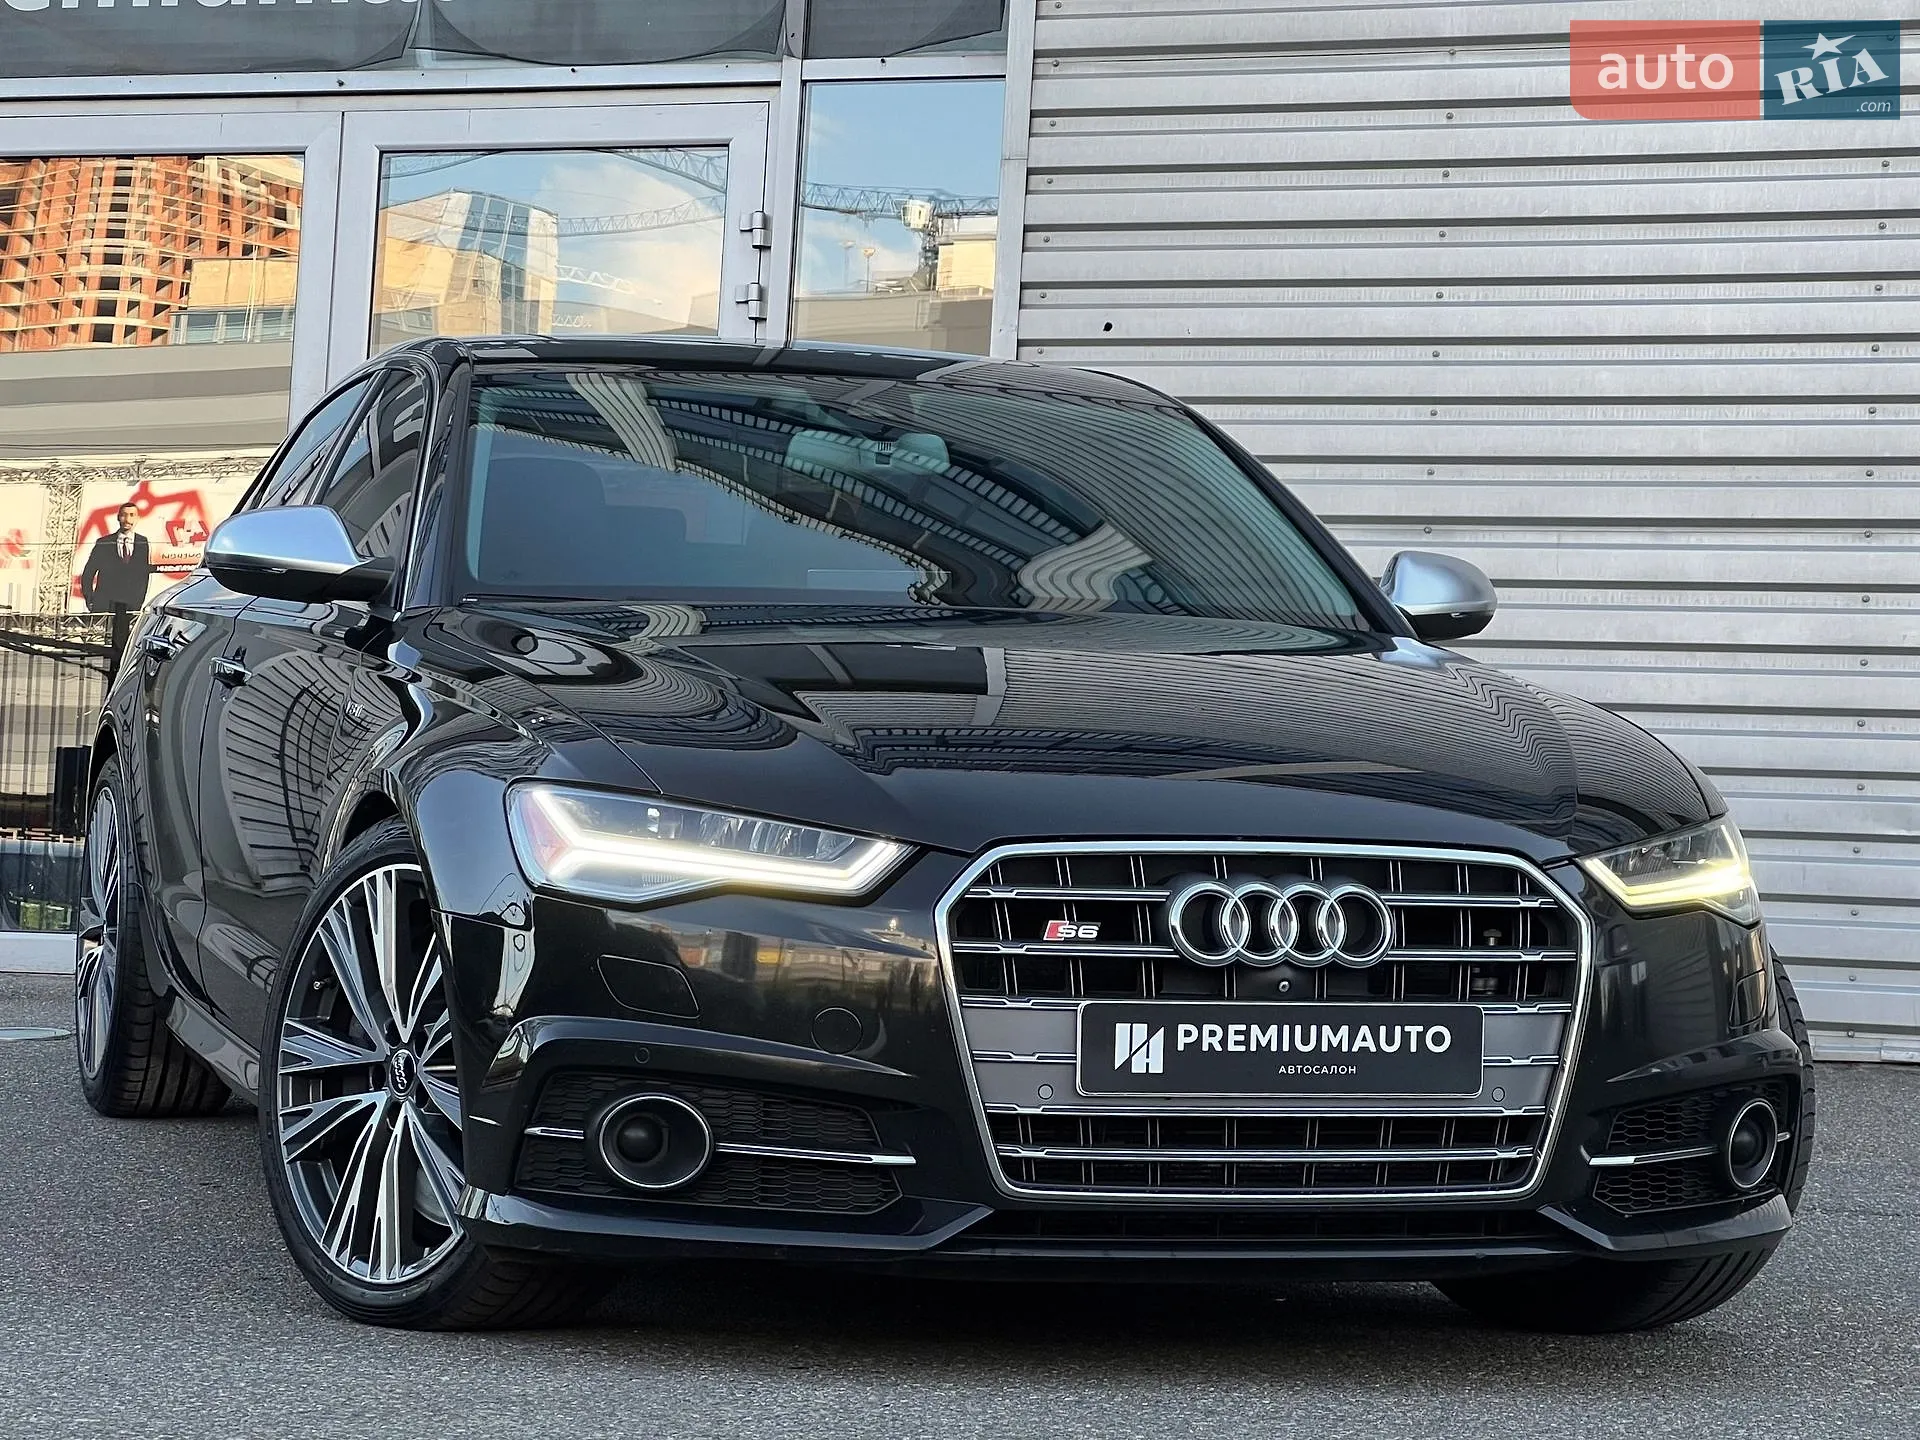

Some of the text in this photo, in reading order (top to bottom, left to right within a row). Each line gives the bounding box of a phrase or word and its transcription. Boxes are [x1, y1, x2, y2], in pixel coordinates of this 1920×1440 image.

[1056, 924, 1100, 939] S6
[1177, 1023, 1452, 1053] PREMIUMAUTO
[1278, 1065, 1357, 1075] АВТОСАЛОН
